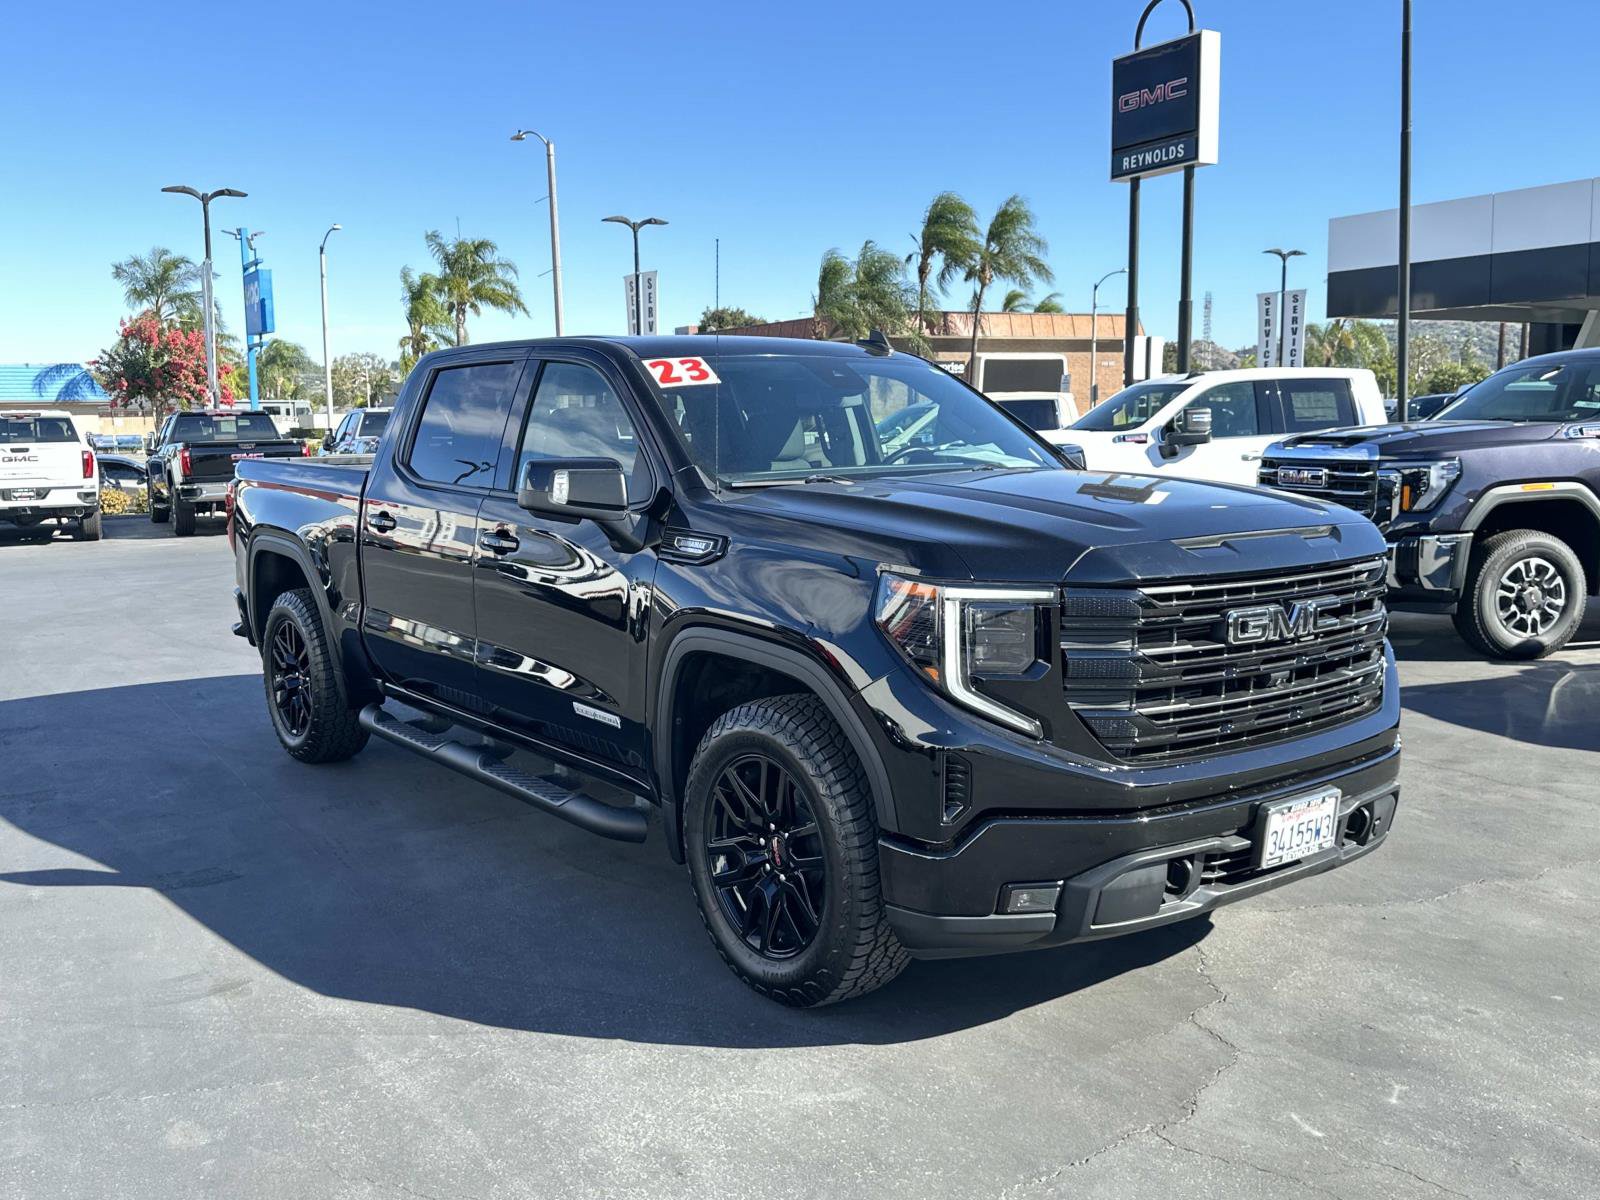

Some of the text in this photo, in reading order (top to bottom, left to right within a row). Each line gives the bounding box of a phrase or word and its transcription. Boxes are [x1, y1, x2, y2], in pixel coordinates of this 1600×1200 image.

[1119, 77, 1188, 113] GMC
[1122, 143, 1185, 170] REYNOLDS
[1263, 297, 1271, 368] SERVICE
[1289, 294, 1299, 368] SERVICE
[648, 358, 710, 384] 23
[2, 455, 39, 463] GMC
[1280, 469, 1323, 485] GMC
[1227, 596, 1341, 645] GMC
[1268, 814, 1332, 856] 34155W3
